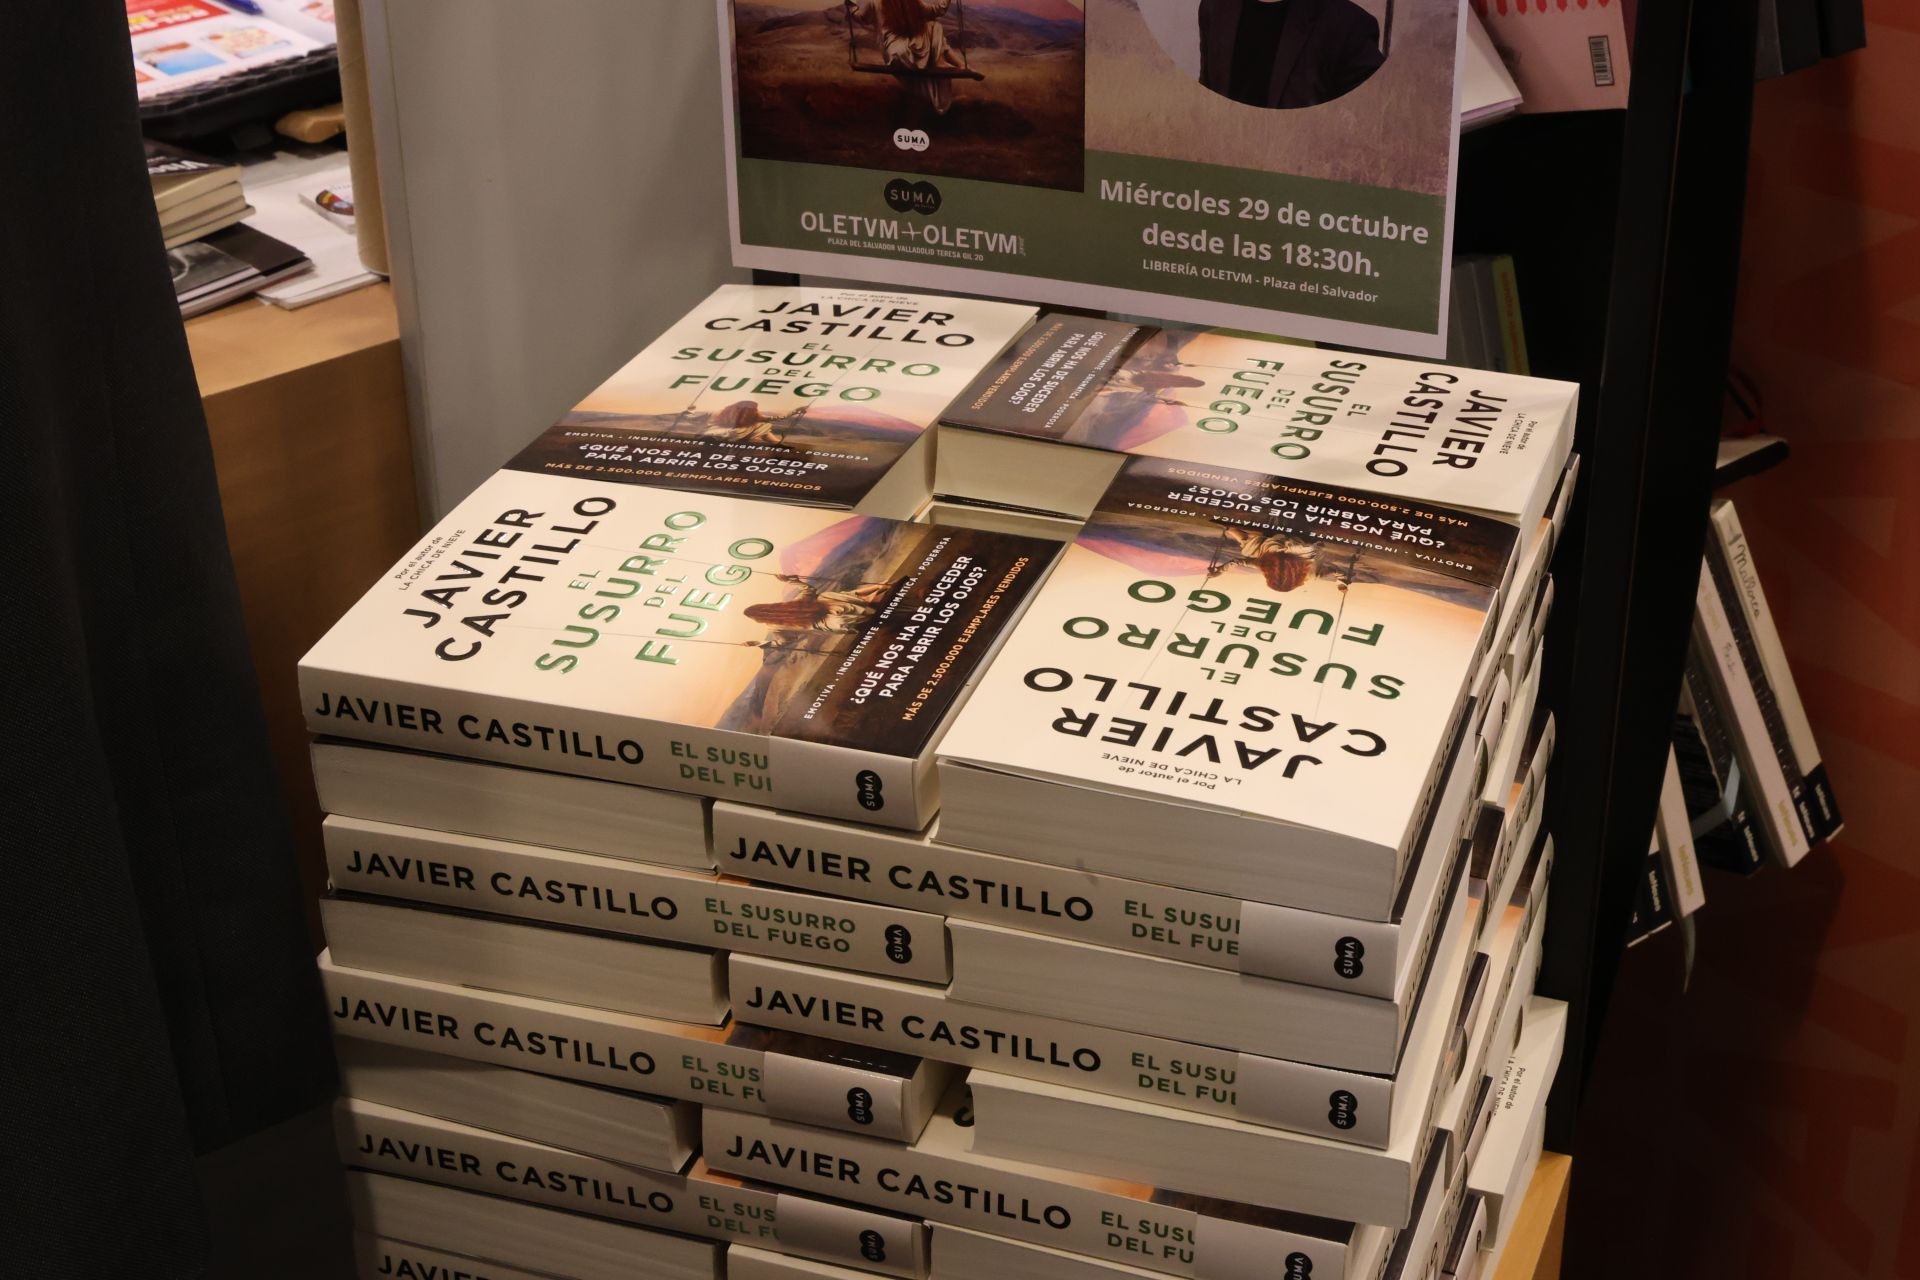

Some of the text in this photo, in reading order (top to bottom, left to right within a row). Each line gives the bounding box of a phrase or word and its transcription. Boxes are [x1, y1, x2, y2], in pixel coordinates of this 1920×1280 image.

[897, 134, 926, 146] SUMA
[889, 189, 935, 204] SUMA
[1100, 178, 1430, 245] Miércoles 29 de octubre
[800, 211, 898, 240] OLETVM
[923, 224, 1018, 255] OLETVM
[828, 238, 848, 247] PLAZA
[850, 239, 862, 248] DEL
[863, 240, 896, 251] SALVADOR
[897, 244, 935, 256] VALLADOLID
[936, 249, 961, 259] TERESA
[1142, 223, 1380, 277] desde las 18:30h.
[1142, 258, 1198, 277] LIBRERÍA
[1201, 267, 1252, 285] OLETVM
[1263, 275, 1296, 291] Plaza
[1299, 281, 1319, 294] del
[1322, 285, 1378, 303] Salvador
[704, 317, 975, 347] CASTILLO
[758, 301, 955, 327] JAVIER
[671, 347, 941, 377] SUSURRO
[800, 342, 833, 352] EL
[668, 374, 882, 402] FUEGO
[762, 368, 817, 378] DEL
[1195, 357, 1285, 435] FUEGO
[1266, 388, 1296, 410] DEL
[1269, 358, 1368, 461] SUSURRO
[1346, 402, 1372, 417] EL
[1365, 371, 1460, 477] CASTILLO
[1432, 388, 1508, 470] JAVIER
[579, 443, 829, 471] ¿QUÉ NOS HA DE SUCEDER
[584, 452, 807, 477] PARA ABRIR LOS OJOS?
[1167, 466, 1469, 528] MÁS DE 2.500.000 EJEMPLARES VENDIDOS
[1188, 484, 1432, 536] PARA ABRIR LOS OJOS?
[1127, 501, 1474, 571] EMOTIVA INQUIETANTE ENIGMÁTICA PODEROSA
[1166, 490, 1446, 549] ¿QUÉ NOS HA DE SUCEDER
[402, 507, 547, 629] JAVIER
[434, 496, 617, 662] CASTILLO
[567, 569, 601, 590] EL
[534, 510, 708, 674] SUSURRO
[634, 537, 774, 666] FUEGO
[643, 574, 689, 608] DEL
[804, 536, 951, 720] EMOTIVA INQUIETANTE ENIGMÁTICA PODEROSA
[850, 555, 973, 704] ¿QUÉ NOS HA DE SUCEDER
[1127, 579, 1385, 647] FUEGO
[879, 566, 988, 698] PARA ABRIR LOS OJOS?
[902, 556, 1030, 721] MÁS DE 2.500.000 EJEMPLARES VENDIDOS
[1210, 620, 1278, 643] DEL
[1062, 615, 1406, 700] SUSURRO
[1199, 667, 1242, 686] EL
[315, 691, 645, 765] JAVIER CASTILLO
[1023, 667, 1388, 757] CASTILLO
[670, 740, 698, 760] EL
[1051, 706, 1323, 780] JAVIER
[680, 764, 725, 784] DEL
[1101, 752, 1242, 786] LA CHICA DE NIEVE
[1118, 765, 1216, 790] Por el autor de
[864, 772, 877, 808] SUMA
[346, 850, 679, 921] JAVIER CASTILLO
[729, 836, 1094, 923] JAVIER CASTILLO
[704, 898, 857, 935] EL SUSURRO
[1124, 900, 1155, 921] EL
[713, 919, 852, 954] DEL FUEGO
[893, 928, 905, 961] SUMA
[1131, 922, 1182, 945] DEL
[1342, 940, 1356, 975] SUMA
[333, 996, 657, 1076] JAVIER CASTILLO
[745, 985, 1102, 1073] JAVIER CASTILLO
[1131, 1052, 1162, 1071] EL
[1137, 1074, 1188, 1096] DEL
[854, 1091, 866, 1122] SUMA
[1336, 1091, 1350, 1127] SUMA
[358, 1133, 675, 1214] JAVIER CASTILLO
[726, 1134, 1072, 1231] JAVIER CASTILLO
[1101, 1210, 1129, 1230] EL
[1108, 1232, 1154, 1256] DEL
